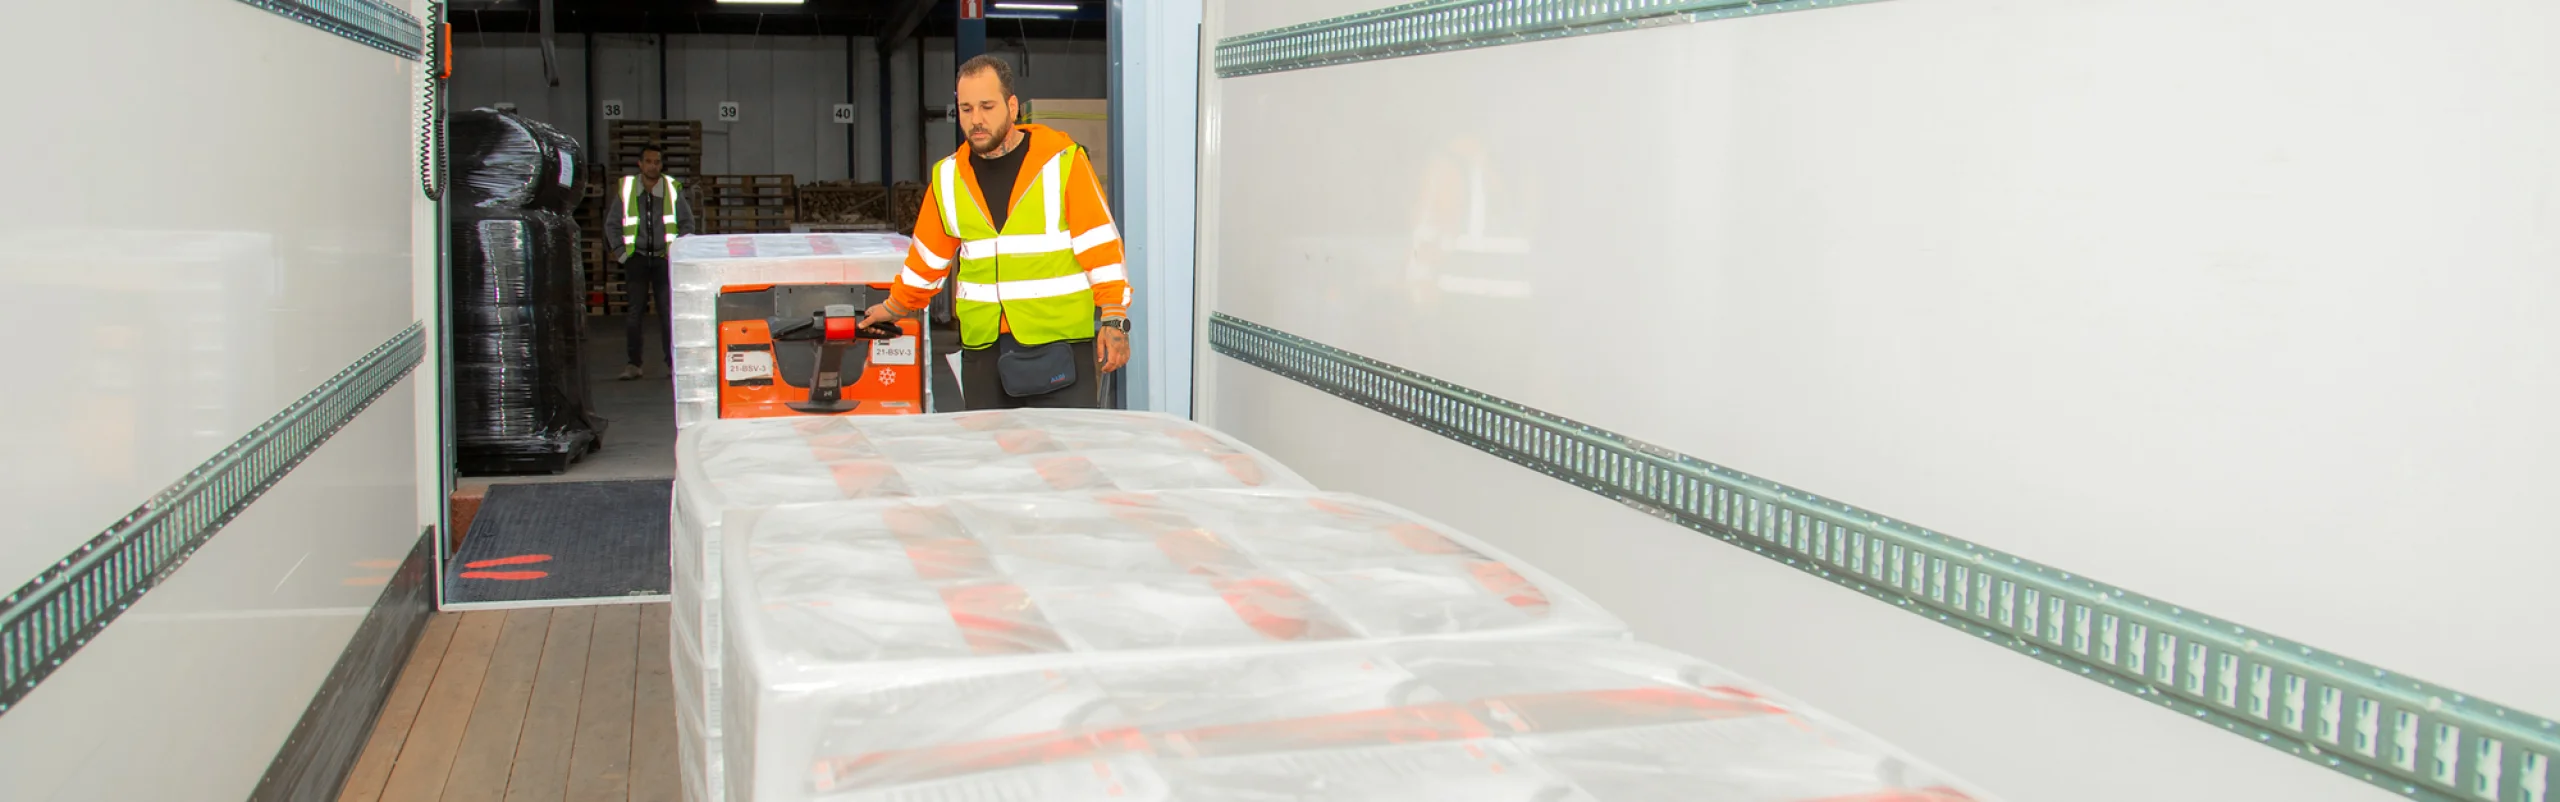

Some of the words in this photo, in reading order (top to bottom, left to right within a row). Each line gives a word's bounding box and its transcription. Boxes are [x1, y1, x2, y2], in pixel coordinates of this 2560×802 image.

[605, 104, 621, 116] 38
[721, 106, 737, 117] 39
[836, 108, 851, 119] 40
